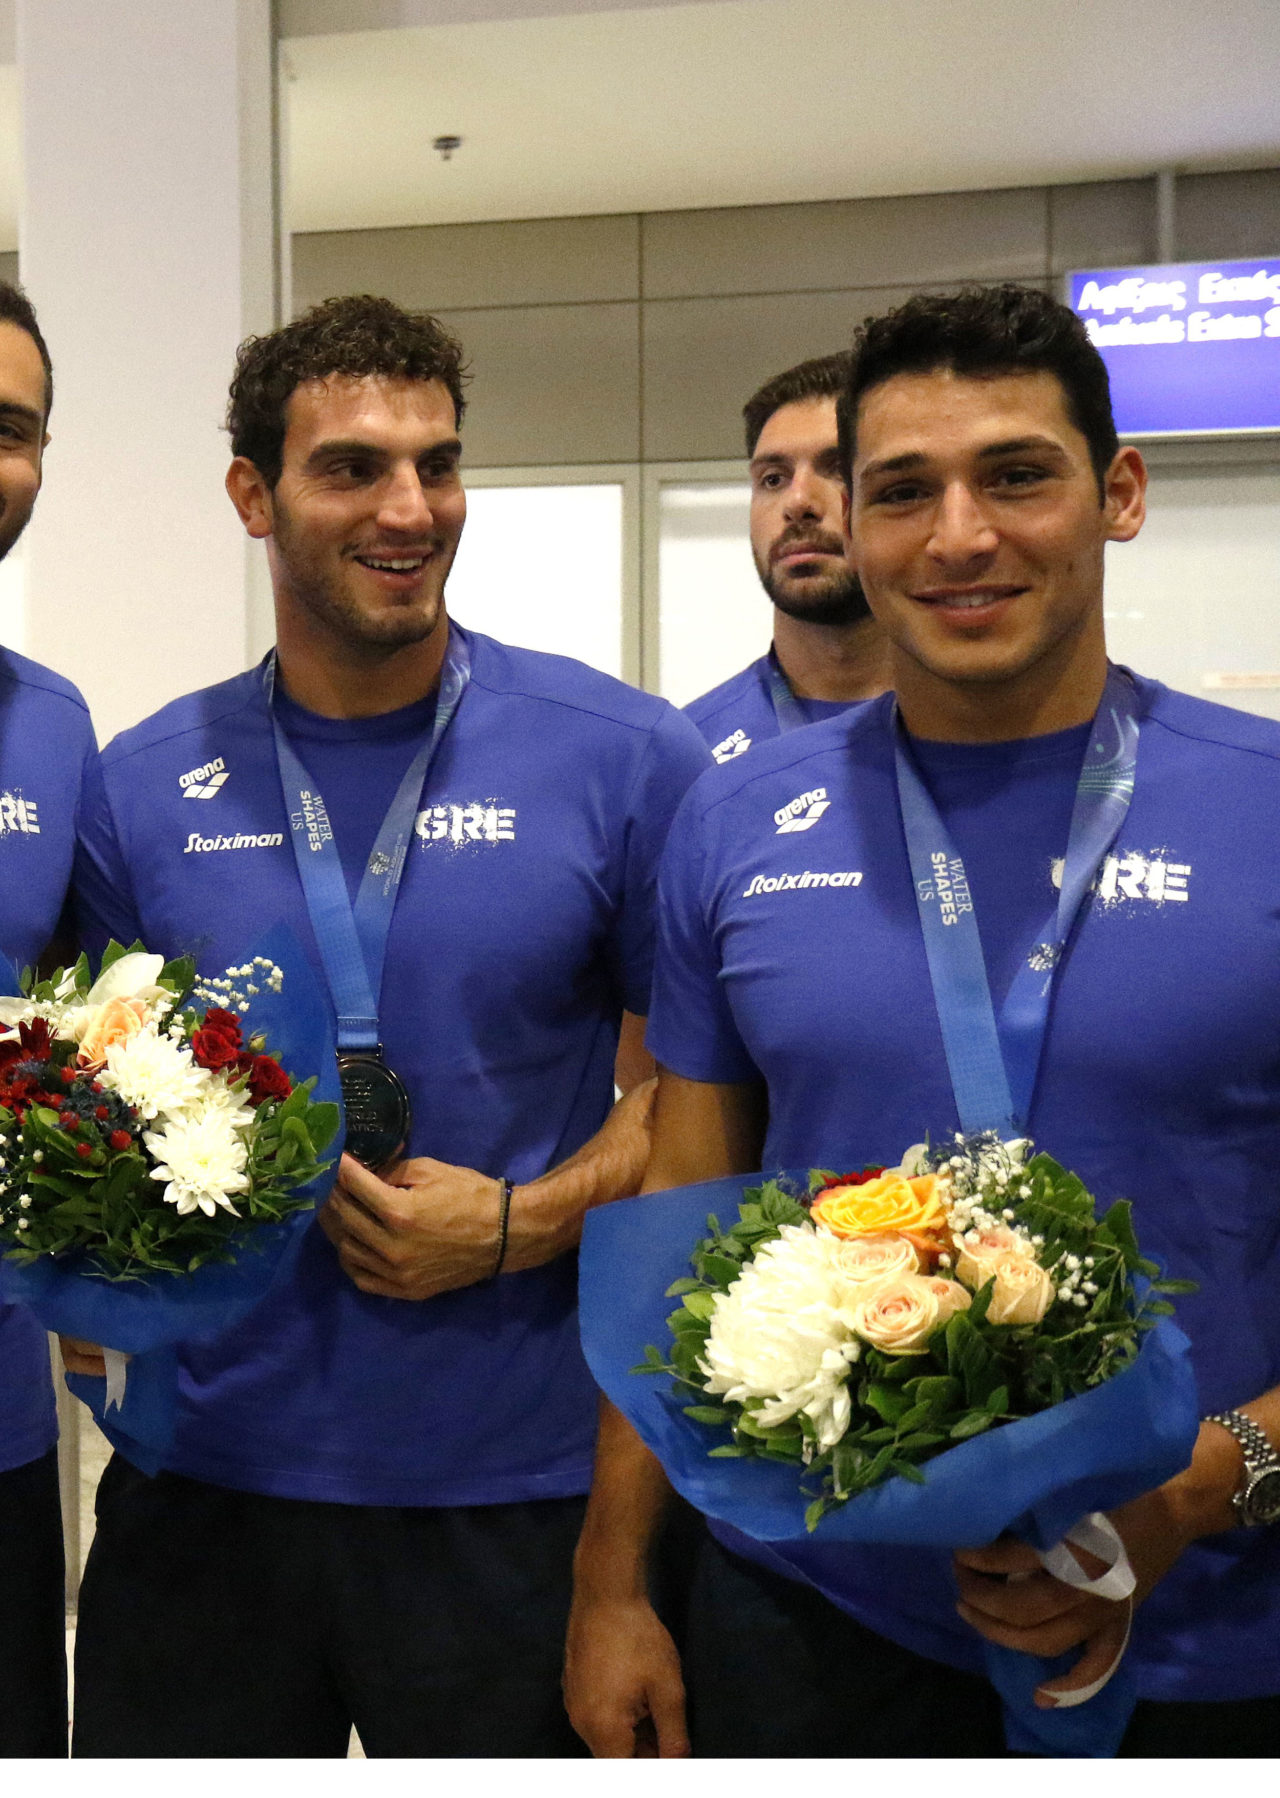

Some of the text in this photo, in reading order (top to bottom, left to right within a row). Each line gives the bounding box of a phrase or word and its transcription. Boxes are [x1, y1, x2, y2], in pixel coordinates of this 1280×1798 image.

[178, 757, 226, 789] arena
[291, 812, 304, 831] US
[300, 791, 322, 851] SHAPES
[313, 796, 333, 843] WATER
[415, 803, 516, 844] GRE
[774, 787, 827, 826] arena
[183, 832, 284, 854] Stoiximan
[743, 870, 863, 898] Stoiximan
[917, 879, 934, 902] US
[931, 852, 958, 926] SHAPES
[949, 858, 973, 915] WATER
